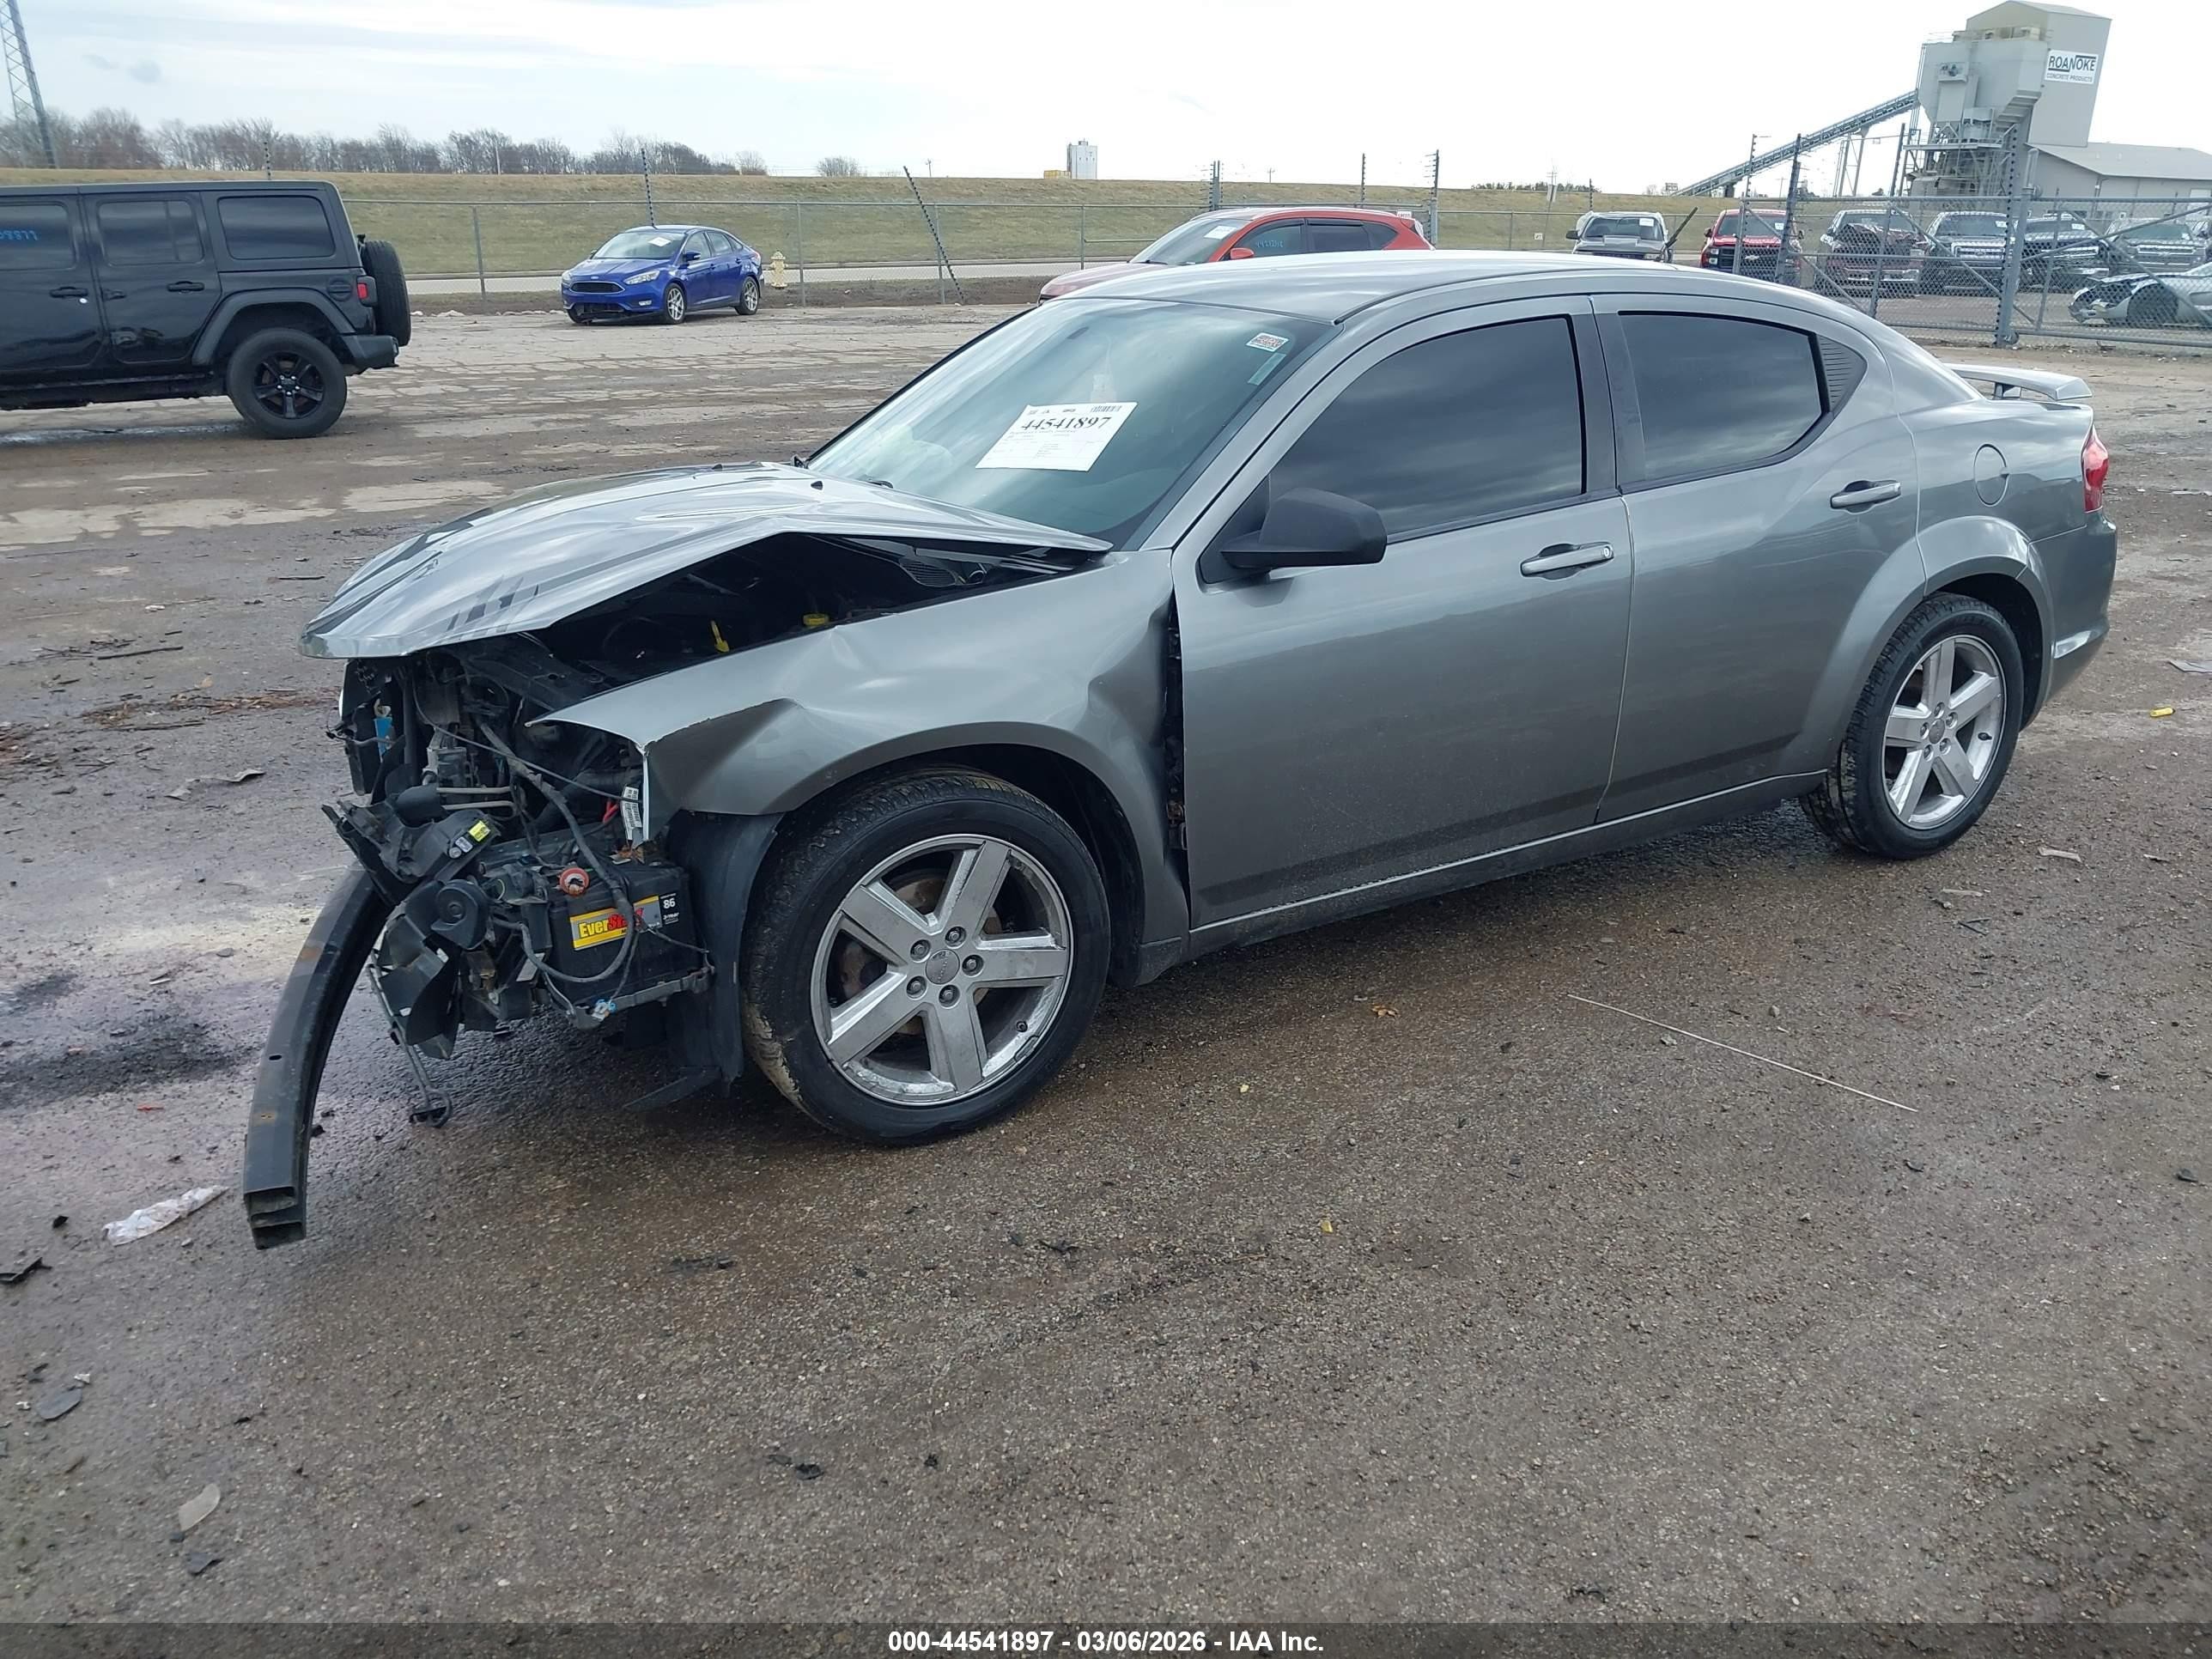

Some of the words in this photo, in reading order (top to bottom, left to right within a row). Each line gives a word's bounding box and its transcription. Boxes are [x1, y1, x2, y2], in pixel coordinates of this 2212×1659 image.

[2048, 55, 2096, 72] ROANOKE
[1021, 416, 1112, 430] 44541897
[663, 897, 676, 908] 86
